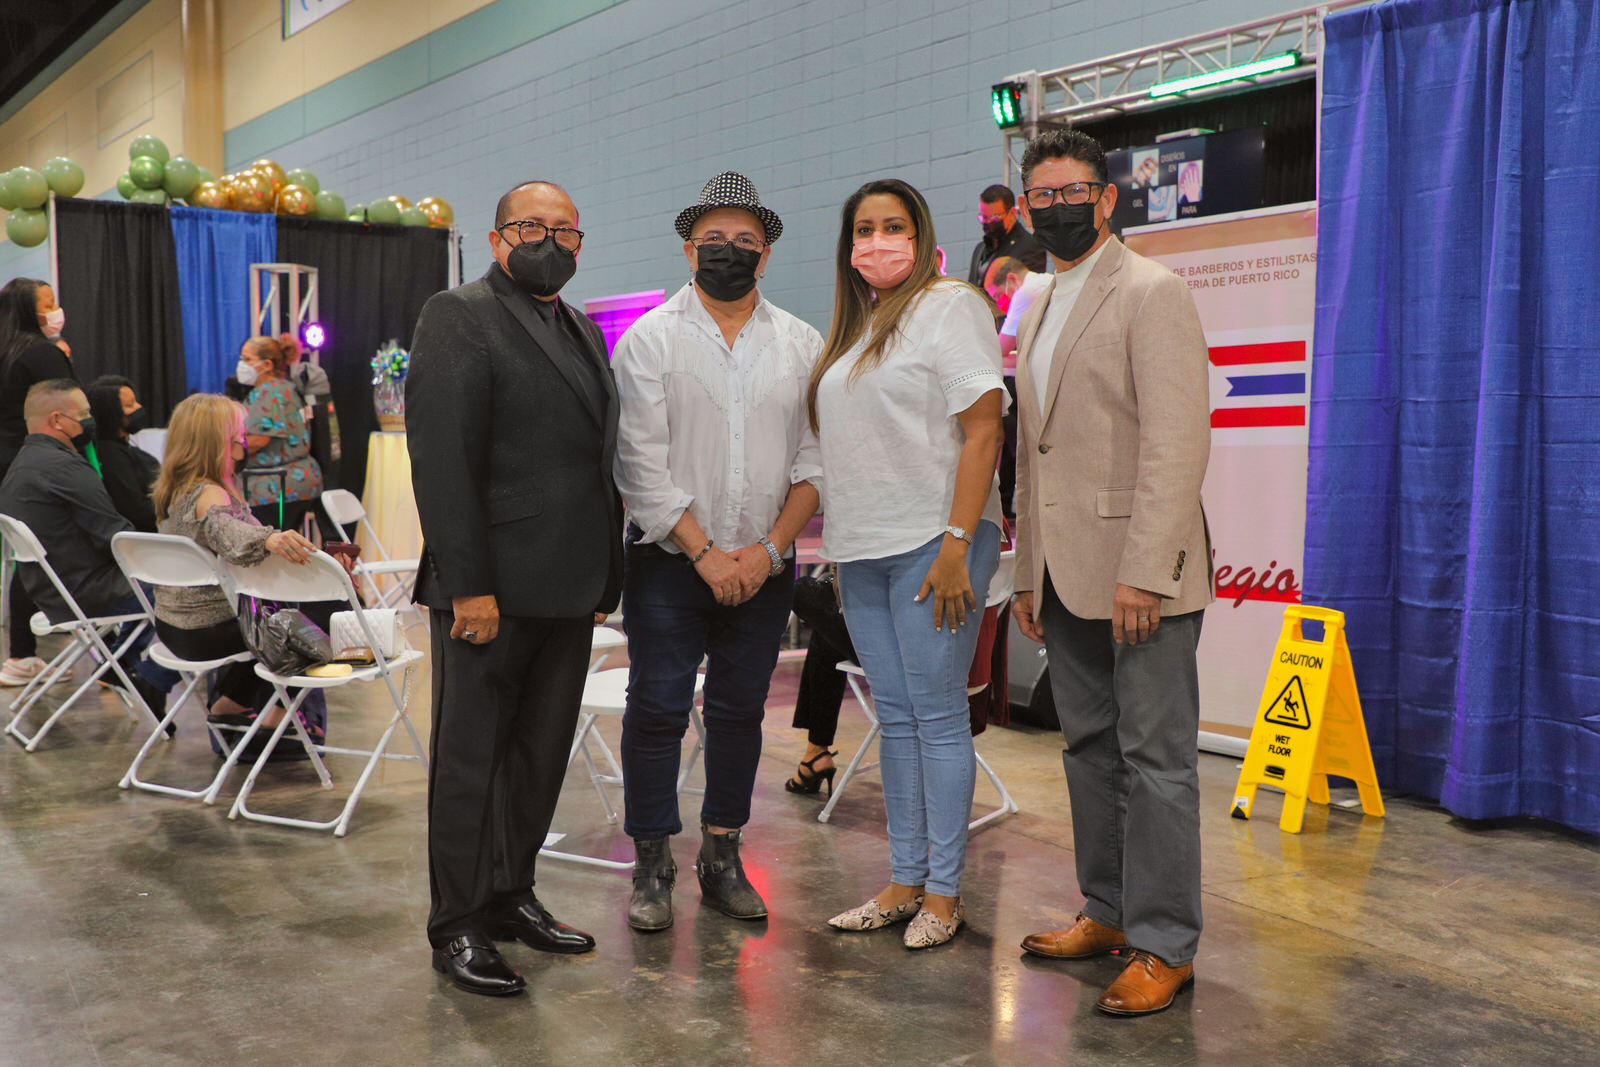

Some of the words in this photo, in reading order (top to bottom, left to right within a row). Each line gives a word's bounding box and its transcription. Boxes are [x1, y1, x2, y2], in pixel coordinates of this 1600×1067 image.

[1188, 260, 1244, 276] BARBEROS
[1247, 260, 1253, 269] Y
[1256, 252, 1317, 269] ESTILISTAS
[1212, 276, 1226, 288] DE
[1229, 271, 1271, 286] PUERTO
[1273, 268, 1300, 281] RICO
[1213, 548, 1299, 608] egio
[1280, 651, 1324, 670] CAUTION
[1275, 734, 1291, 745] WET
[1268, 744, 1292, 758] FLOOR
